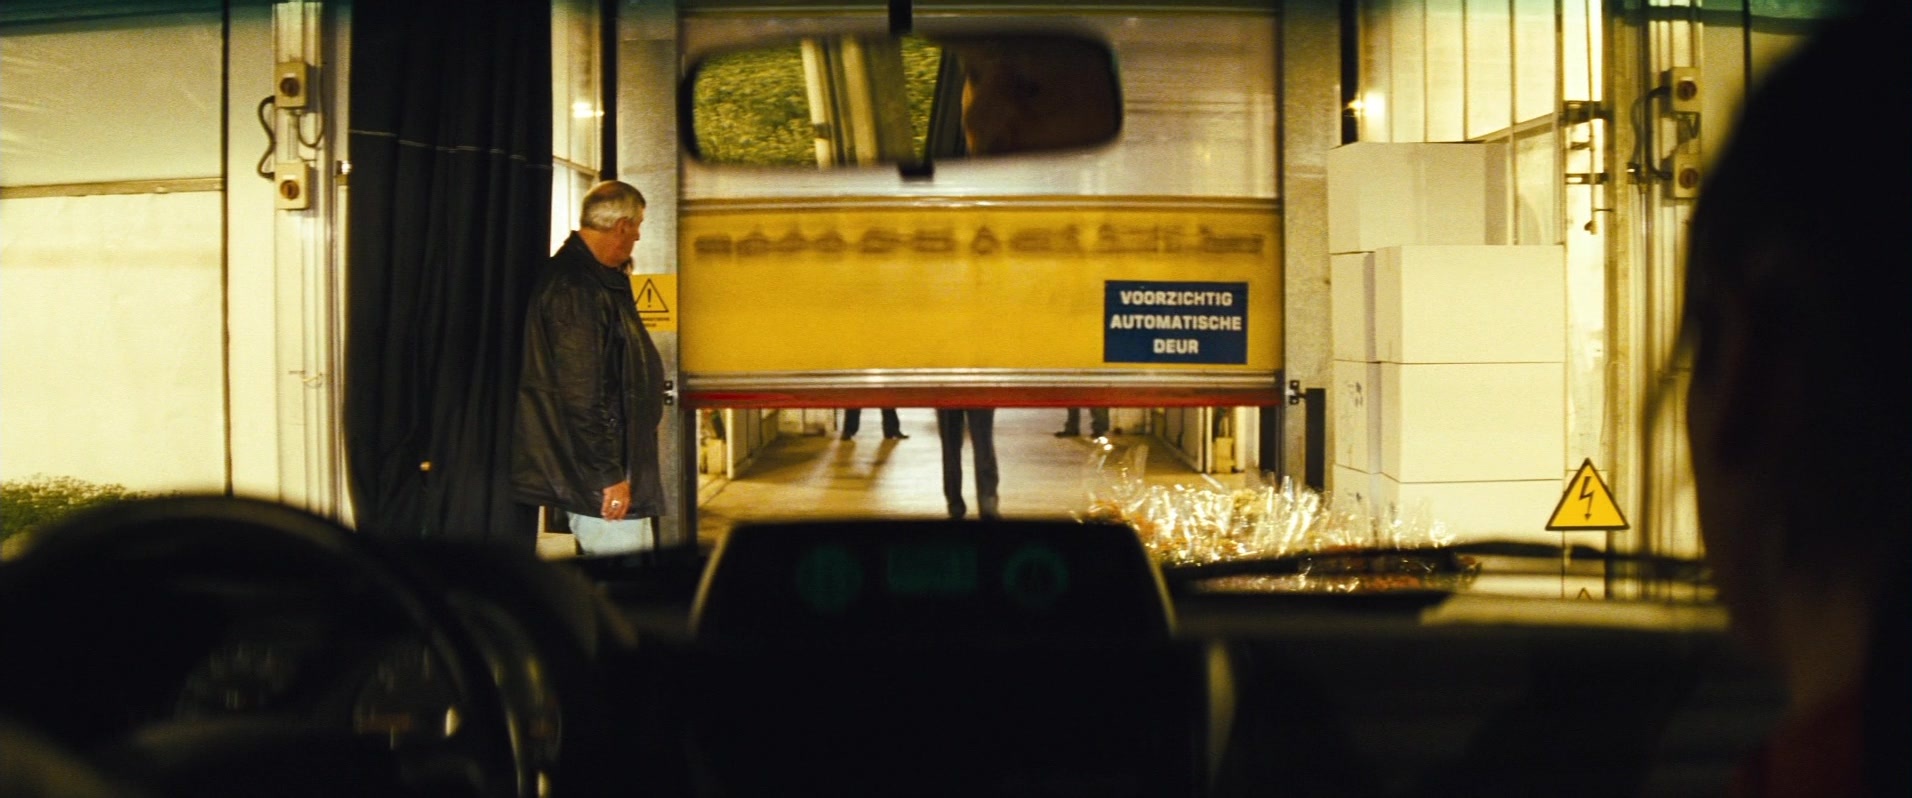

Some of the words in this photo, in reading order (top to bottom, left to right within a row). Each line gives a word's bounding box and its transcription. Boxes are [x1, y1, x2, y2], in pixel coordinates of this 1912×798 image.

[1120, 290, 1233, 306] VOORZICHTIG
[1110, 314, 1243, 331] AUTOMATISCHE
[1153, 338, 1199, 354] DEUR
